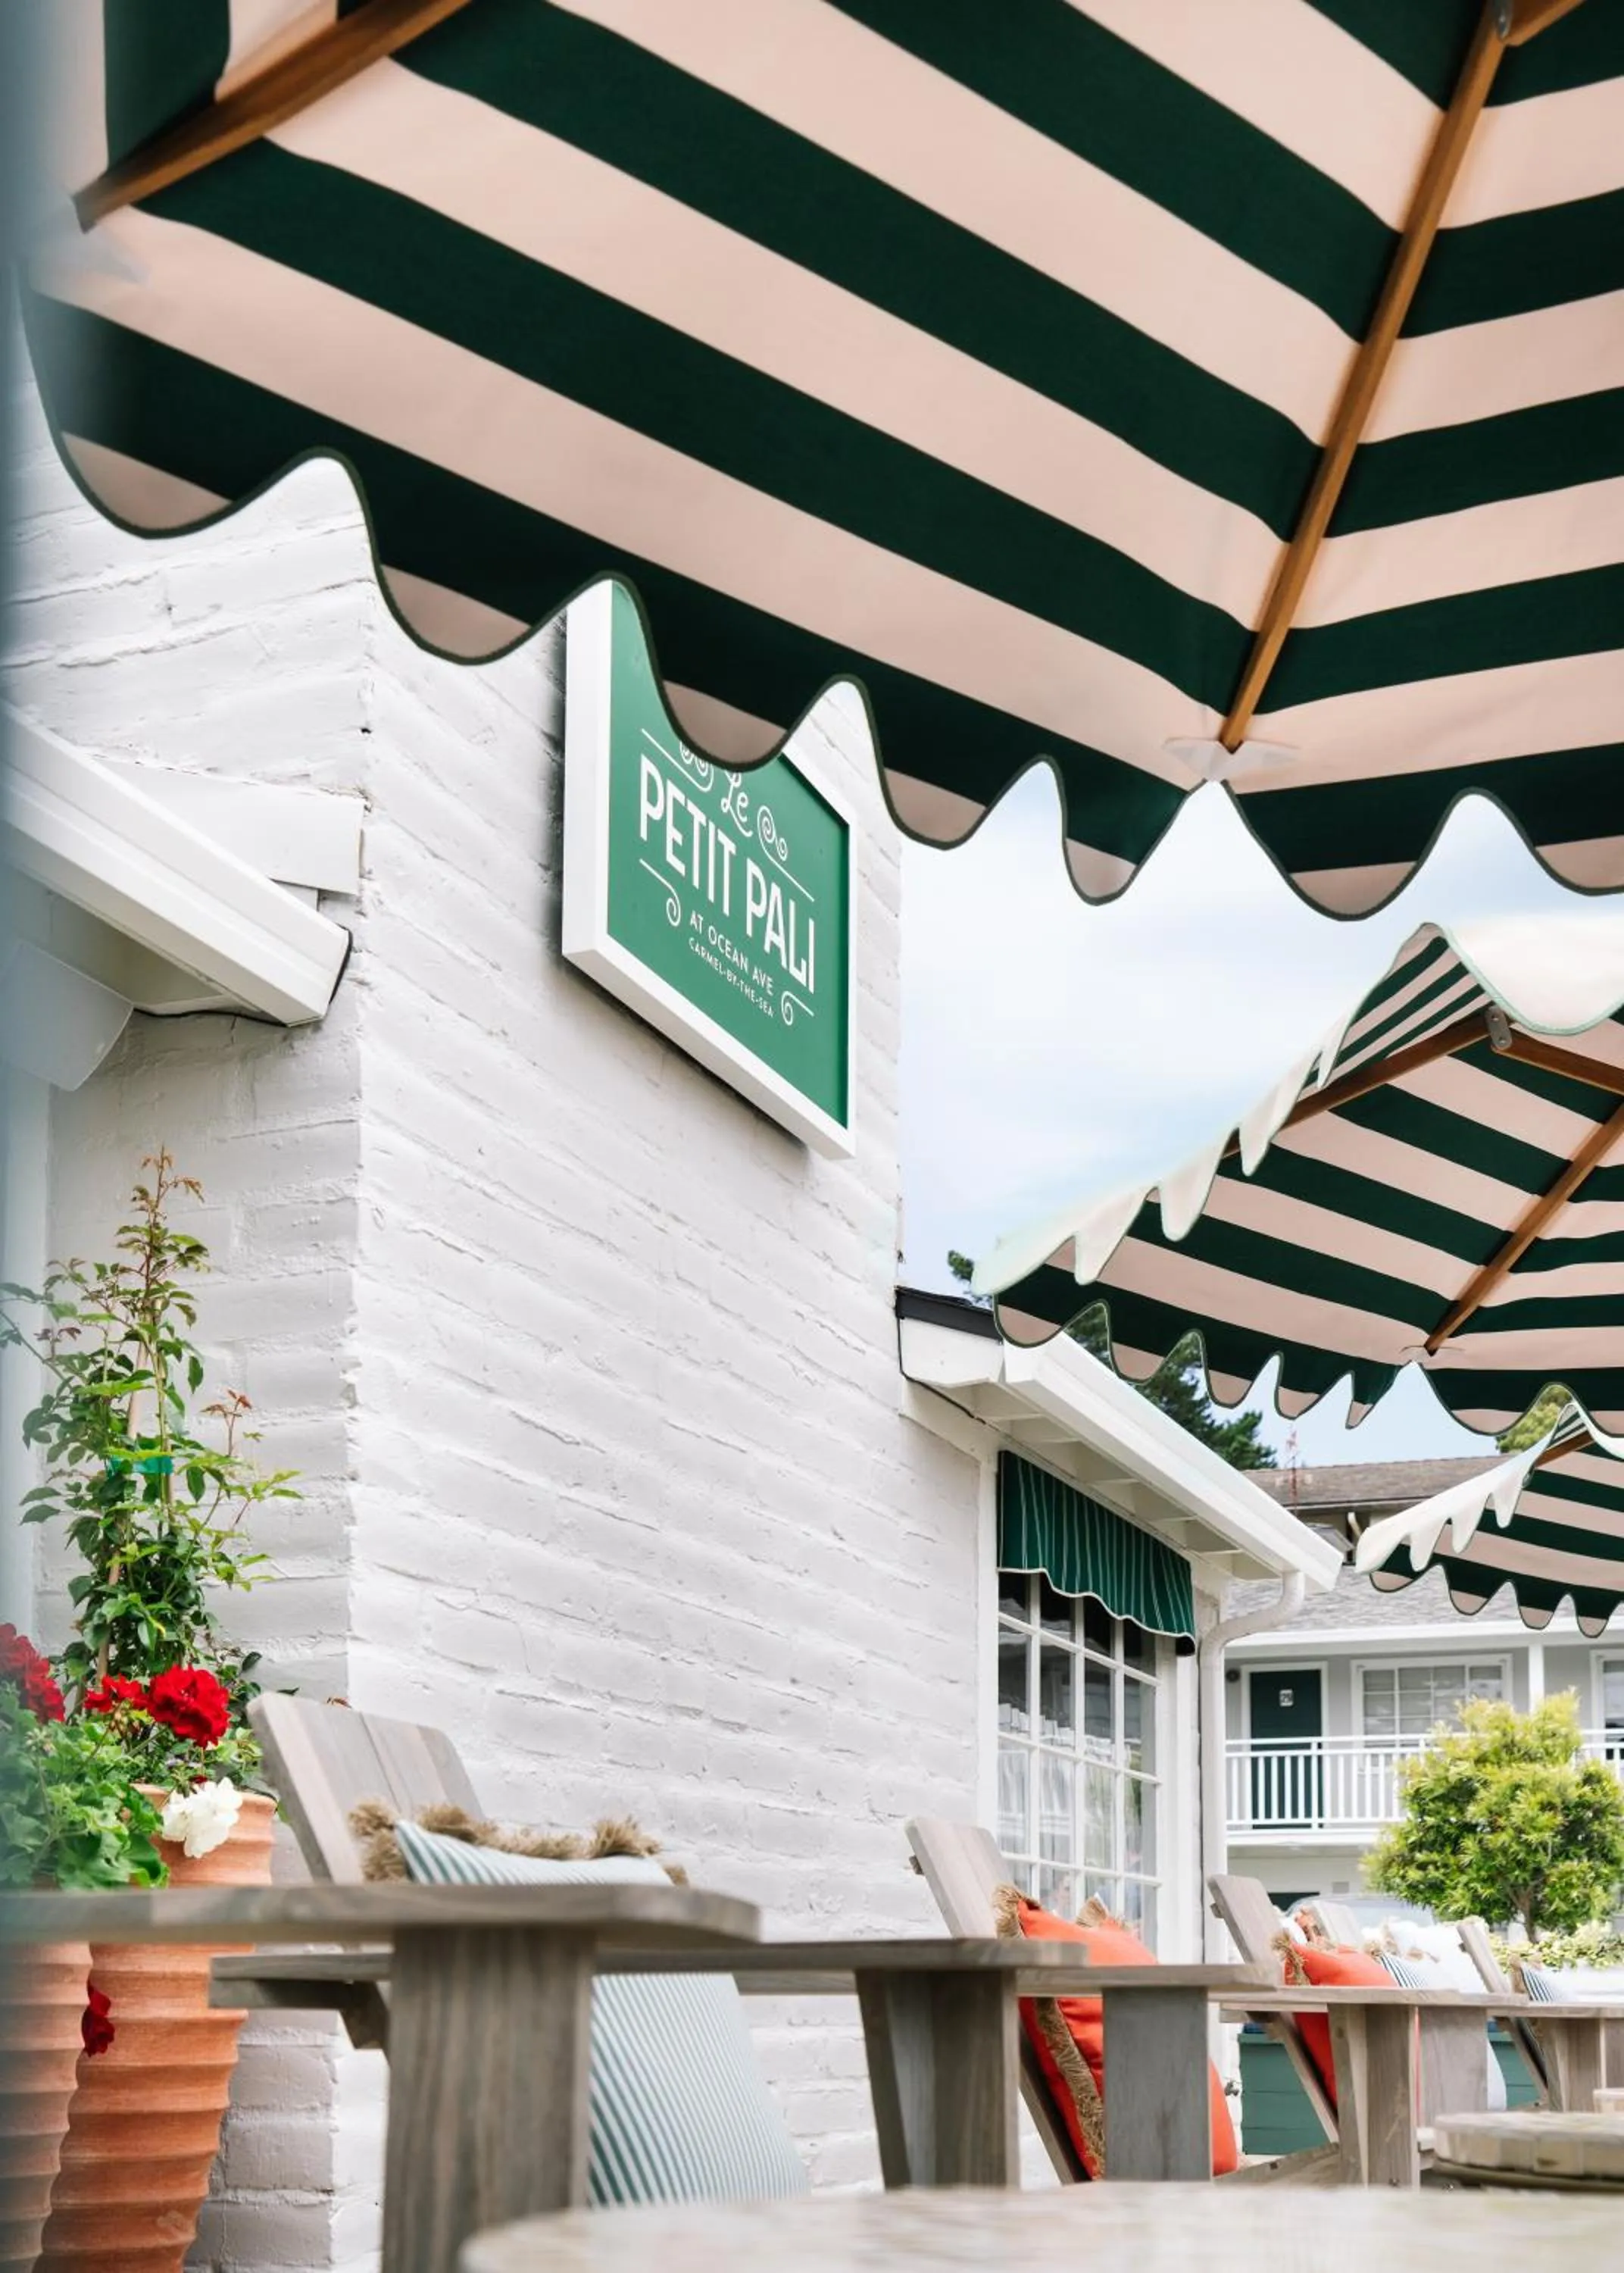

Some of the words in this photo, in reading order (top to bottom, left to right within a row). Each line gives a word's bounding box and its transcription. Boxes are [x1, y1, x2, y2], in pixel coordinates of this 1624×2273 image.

[720, 770, 753, 837] Le
[639, 753, 736, 917] PETIT
[746, 857, 814, 994] PALI
[689, 936, 774, 1018] CARMEL-BY-THE-SEA
[690, 910, 703, 934] AT
[708, 925, 749, 974] OCEAN
[752, 966, 773, 996] AVE
